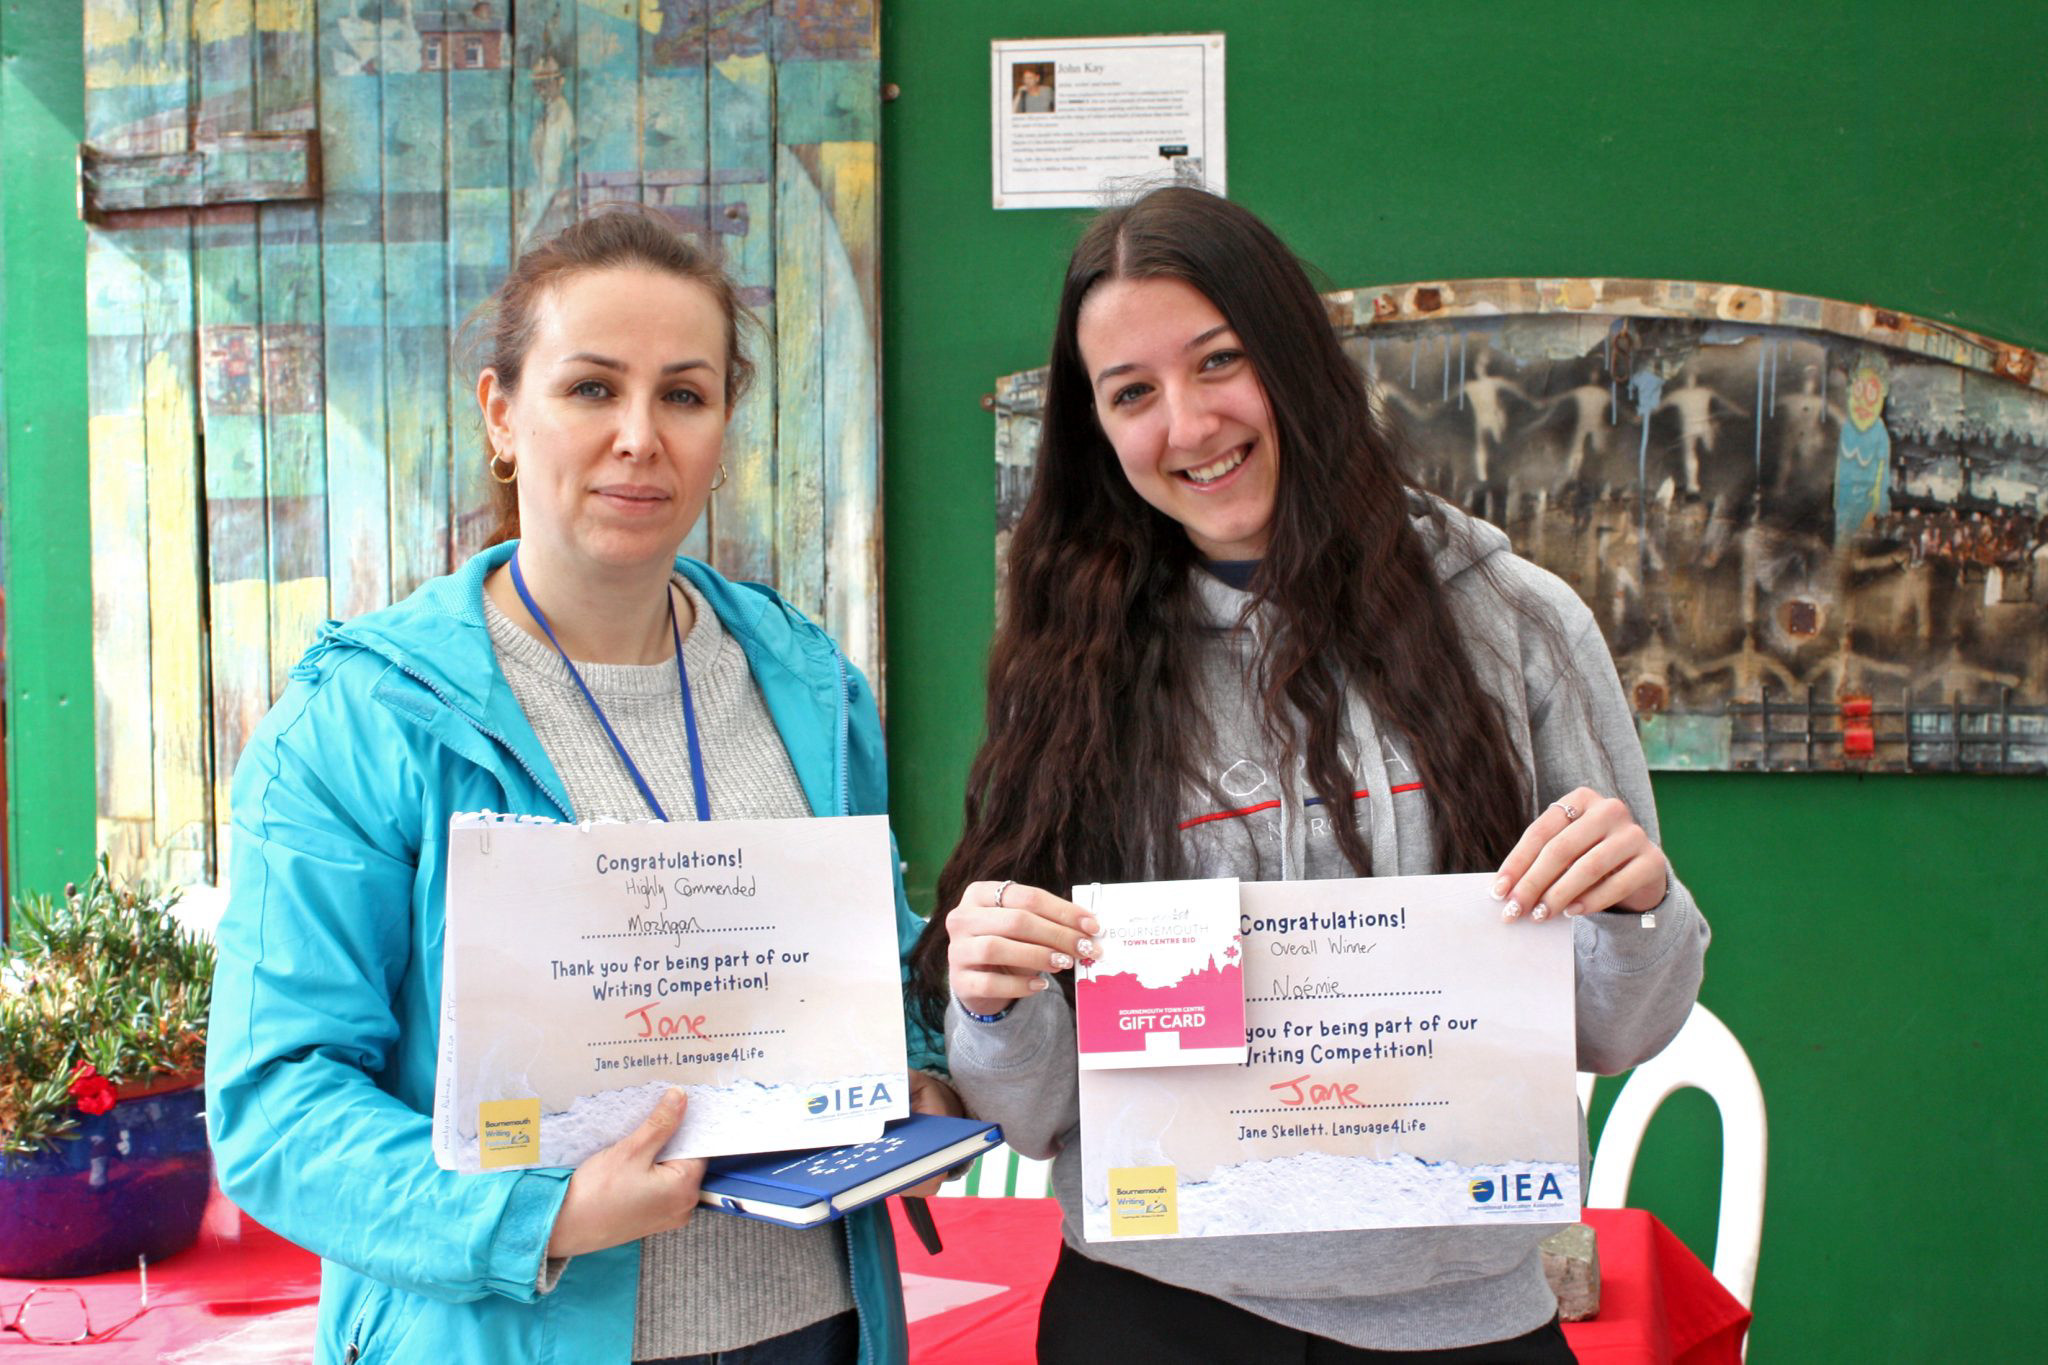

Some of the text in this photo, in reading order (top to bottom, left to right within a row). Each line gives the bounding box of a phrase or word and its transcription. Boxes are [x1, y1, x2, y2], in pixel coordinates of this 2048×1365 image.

[1058, 62, 1105, 76] John Kay
[597, 848, 742, 874] Congratulations!
[625, 875, 756, 910] Highly Commended
[1110, 925, 1209, 939] BOURNEMOUTH
[1240, 907, 1406, 935] Congratulations!
[1271, 939, 1318, 956] Overall
[551, 949, 809, 980] Thank you for being part of our
[593, 972, 768, 1001] Writing Competition!
[1273, 975, 1343, 999] Noémie
[625, 1002, 710, 1041] Jane
[1119, 1007, 1164, 1015] BOURNEMOUTH
[1119, 1014, 1206, 1030] GIFT CARD
[1245, 1014, 1478, 1043] you for being part of our
[595, 1058, 620, 1072] Jane
[676, 1048, 764, 1065] Language4Life
[1311, 1039, 1433, 1064] Competition!
[835, 1083, 893, 1112] IEA
[1269, 1075, 1367, 1107] Jane
[486, 1117, 531, 1128] Bournemouth
[486, 1130, 510, 1138] Writing
[1238, 1126, 1267, 1141] Jane
[1332, 1119, 1426, 1136] Language4Life
[1116, 1186, 1167, 1195] Bournemouth
[1501, 1172, 1563, 1202] IEA
[1117, 1198, 1145, 1206] Writing
